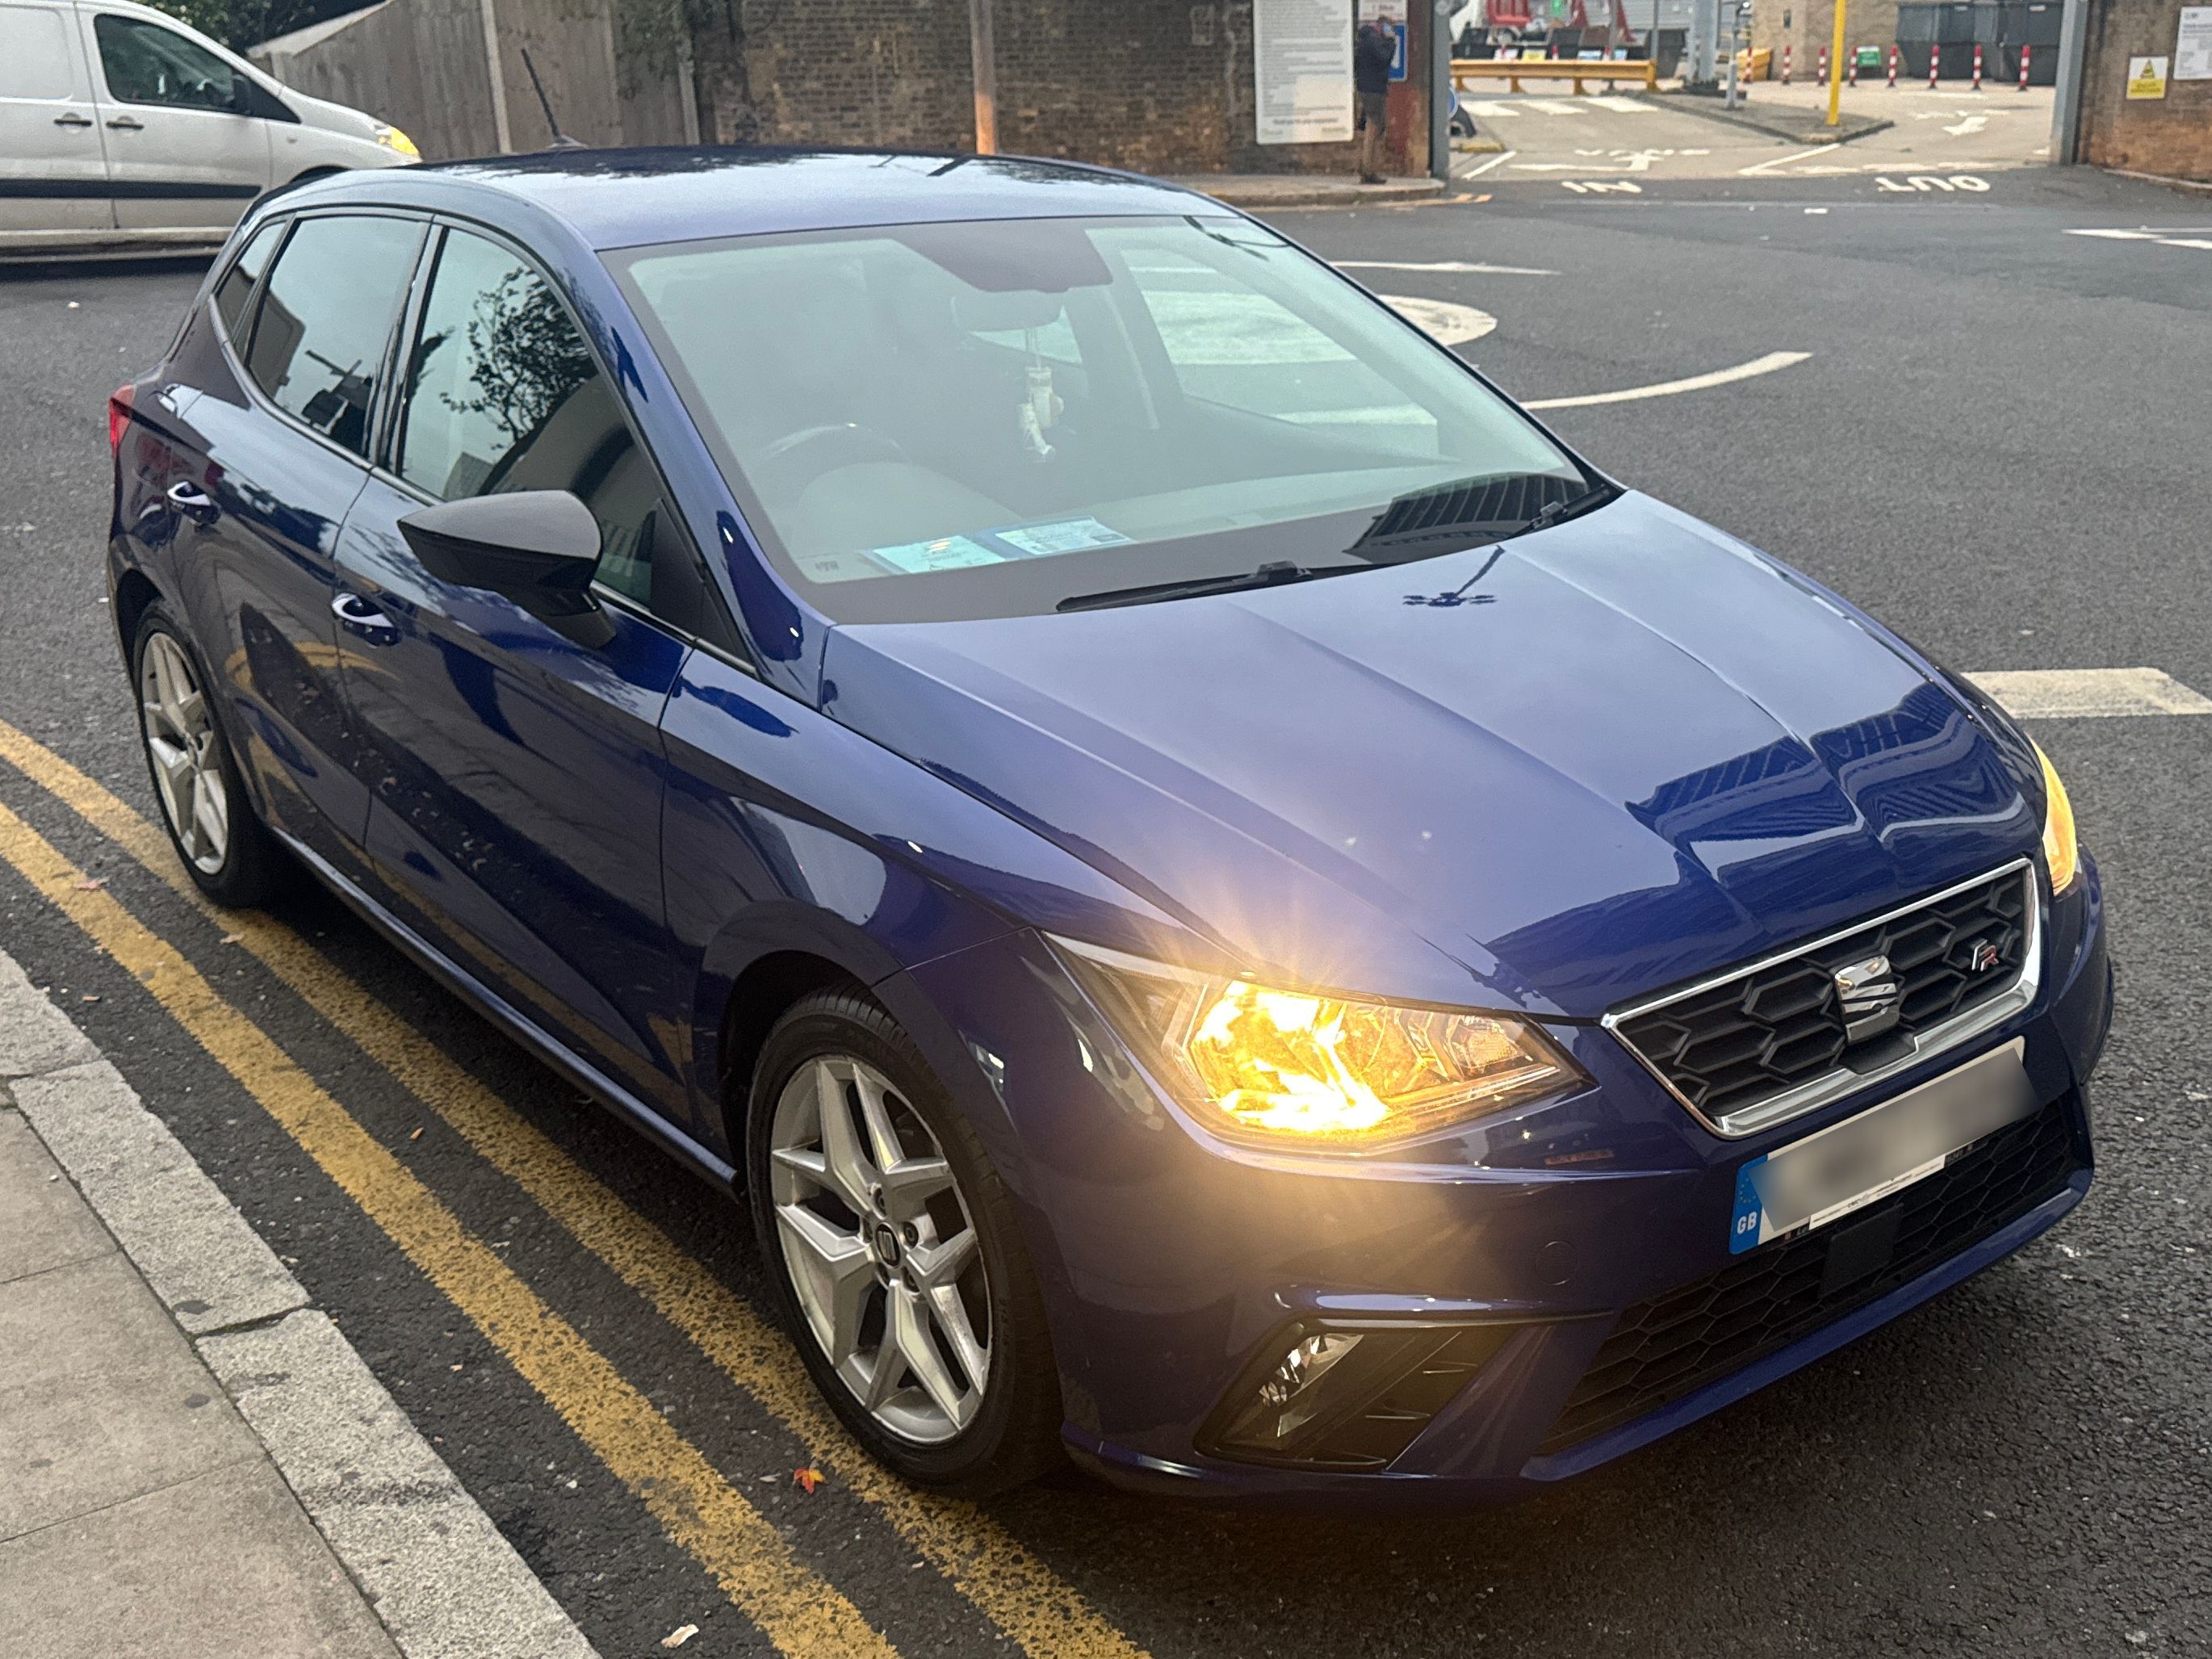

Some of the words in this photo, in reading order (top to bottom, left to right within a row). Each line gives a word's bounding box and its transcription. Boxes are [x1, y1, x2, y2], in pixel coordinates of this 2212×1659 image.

[1561, 182, 1642, 193] IN
[1875, 175, 1991, 192] OUT
[1971, 938, 2000, 972] FR
[1737, 1211, 1757, 1234] GB
